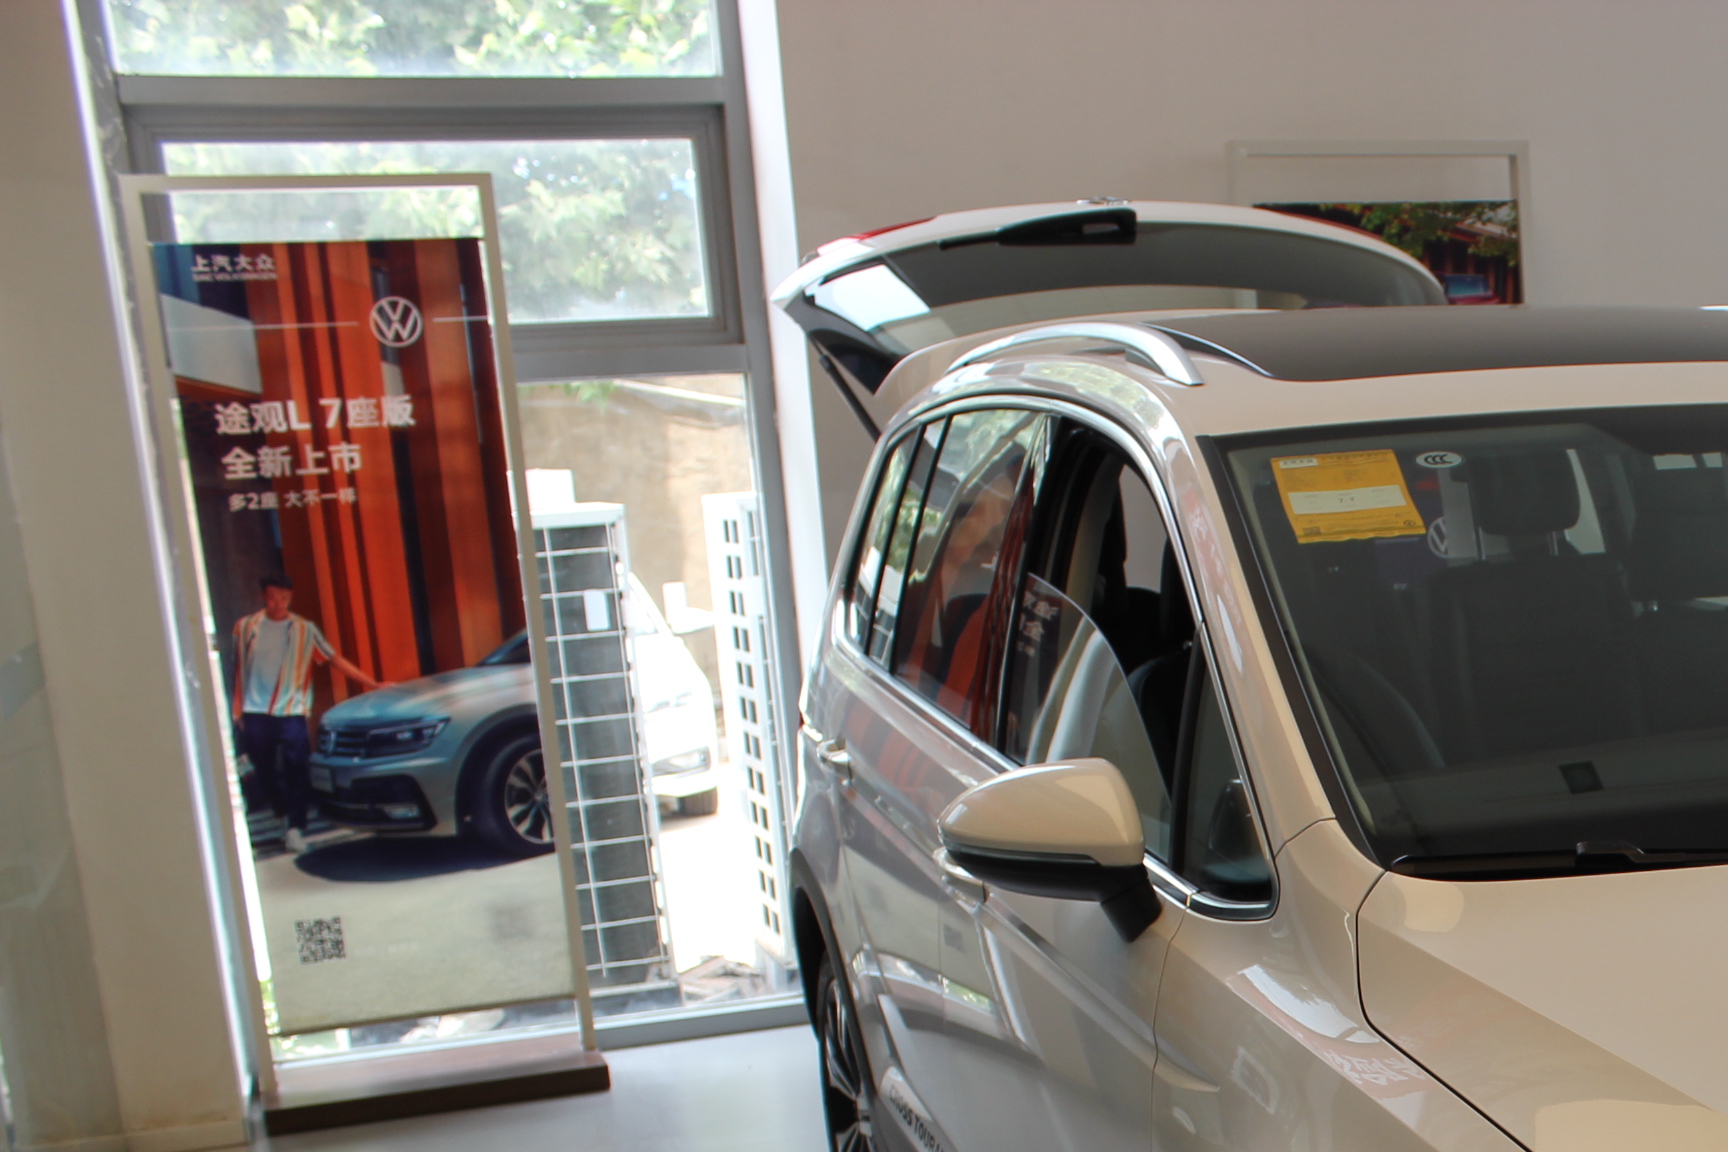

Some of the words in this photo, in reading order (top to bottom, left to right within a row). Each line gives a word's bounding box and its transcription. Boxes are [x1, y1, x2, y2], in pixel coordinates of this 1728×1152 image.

[191, 254, 276, 272] 上汽大众
[213, 400, 312, 434] 途观L
[318, 394, 417, 429] 7座版
[221, 441, 363, 480] 全新上市
[228, 490, 279, 512] 多2座
